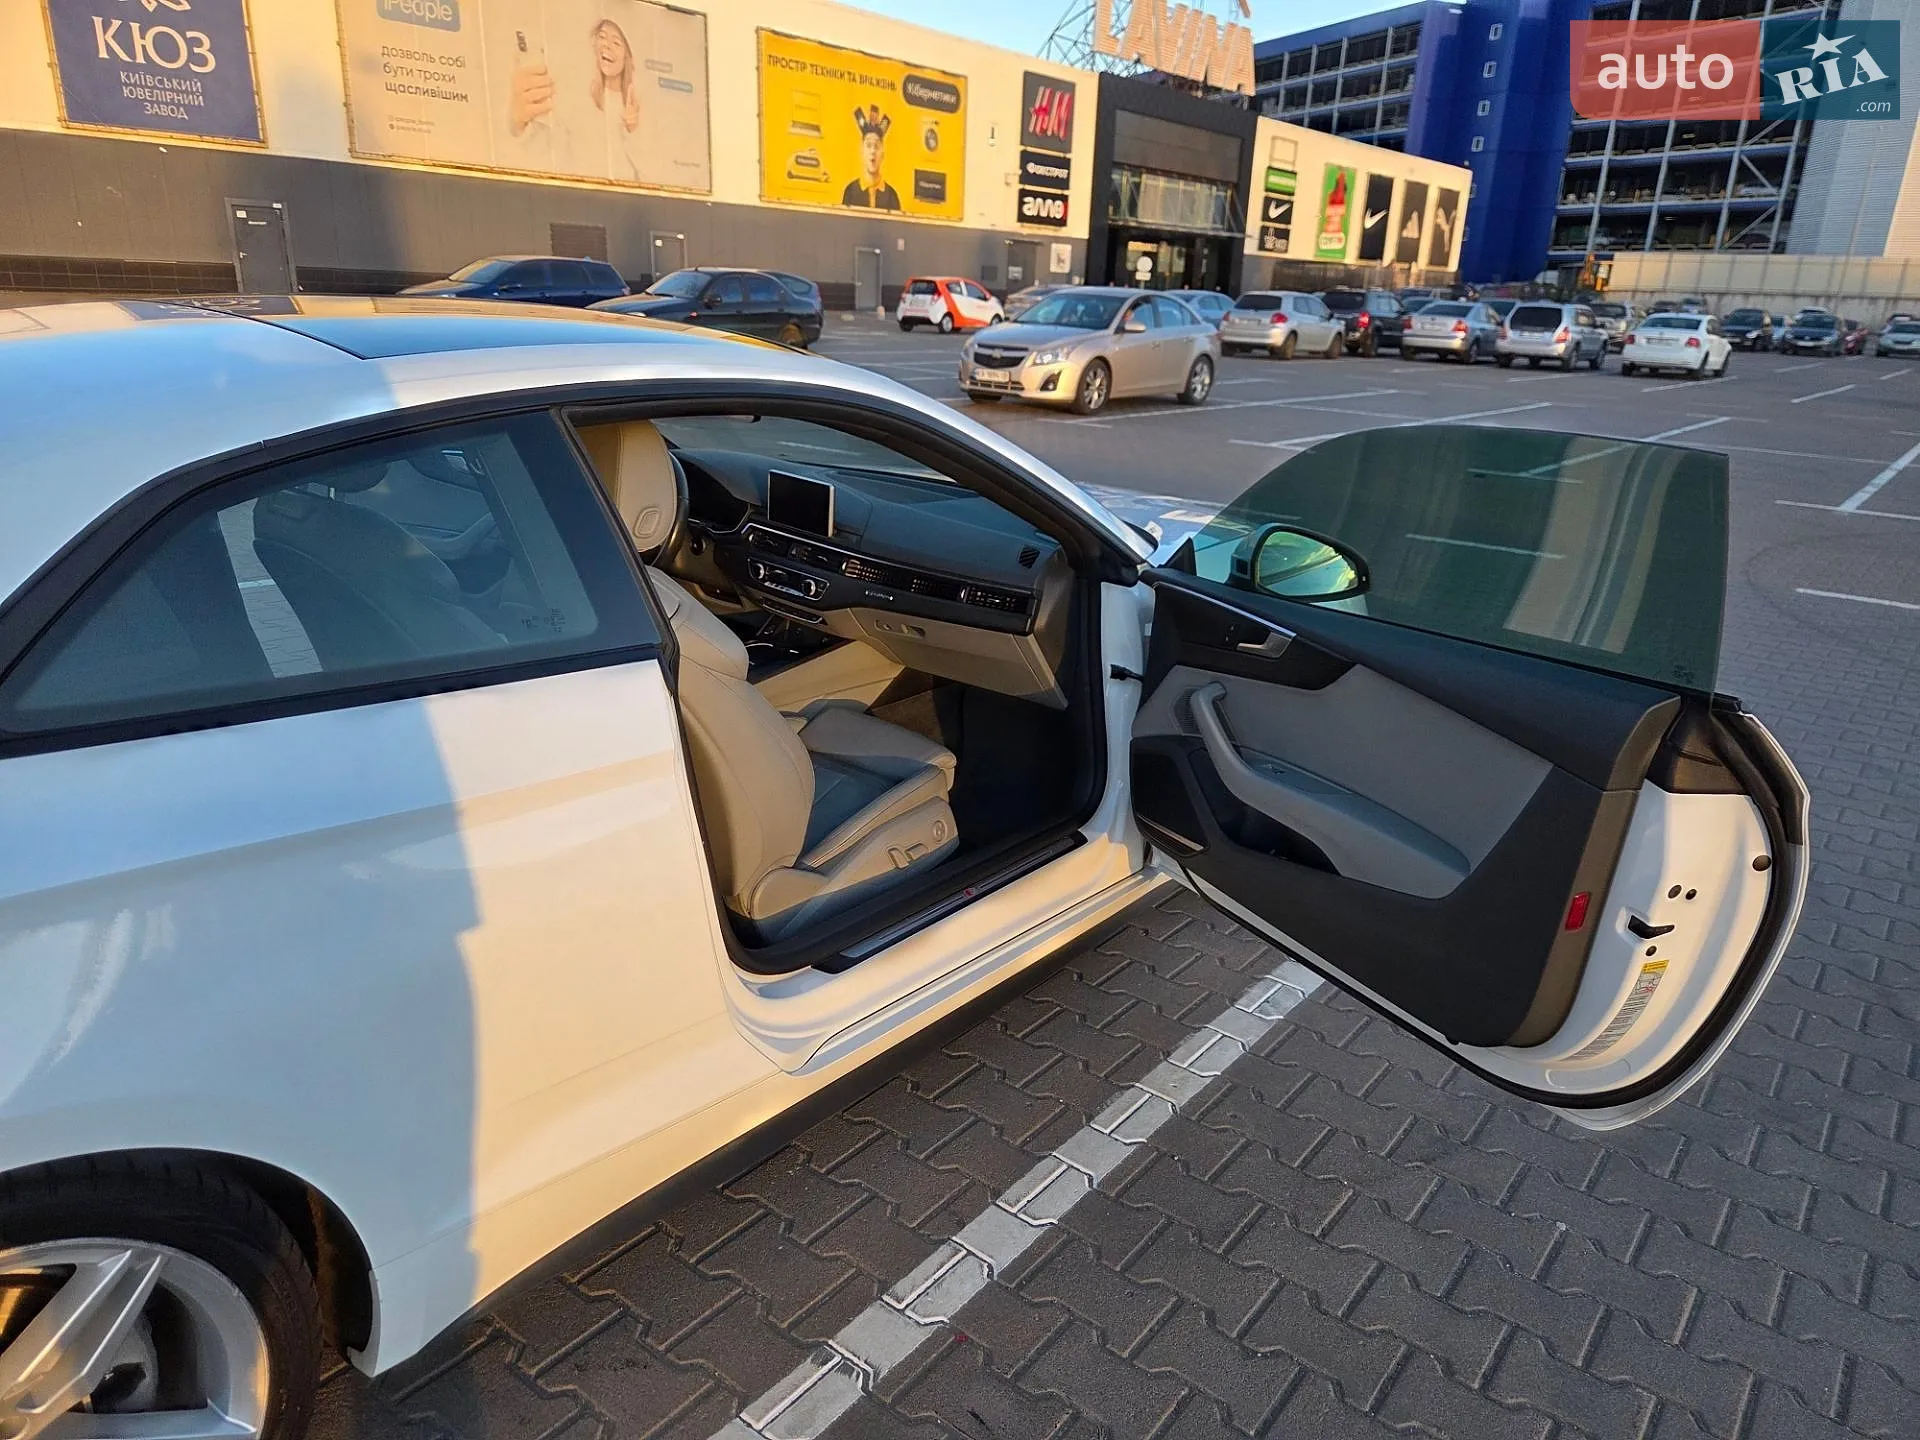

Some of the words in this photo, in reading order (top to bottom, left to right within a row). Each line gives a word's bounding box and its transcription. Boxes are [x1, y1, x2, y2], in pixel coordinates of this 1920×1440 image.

[91, 15, 216, 74] КЮЗ
[381, 45, 436, 65] дозволь
[438, 55, 467, 69] собі
[120, 70, 203, 93] КИЇВСЬКИЙ
[382, 61, 414, 78] бути
[417, 68, 457, 84] трохи
[122, 86, 205, 107] ЮВЕЛІРНИЙ
[384, 81, 470, 104] щасливішим
[143, 102, 189, 121] ЗАВОД
